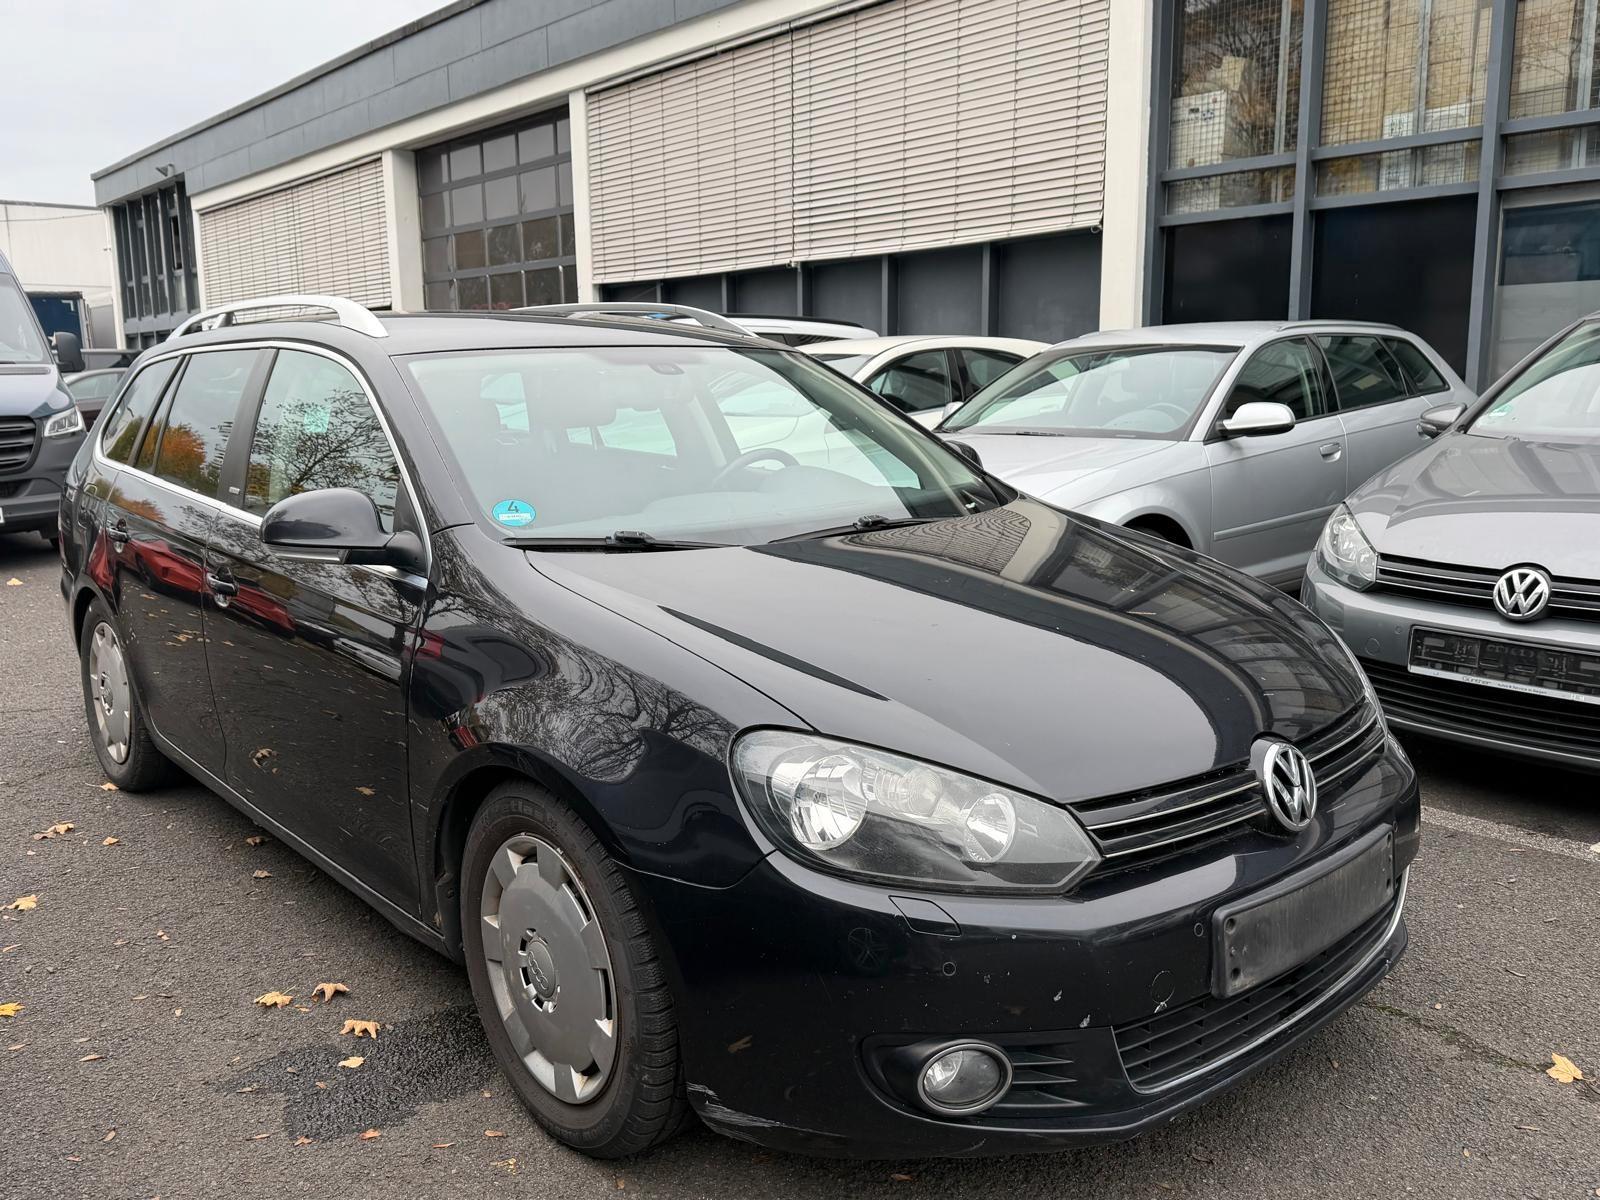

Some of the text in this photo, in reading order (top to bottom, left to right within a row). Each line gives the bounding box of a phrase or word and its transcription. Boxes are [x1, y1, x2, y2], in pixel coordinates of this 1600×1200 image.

[507, 501, 519, 513] 4
[1496, 570, 1546, 617] VW
[1267, 745, 1315, 828] VW
